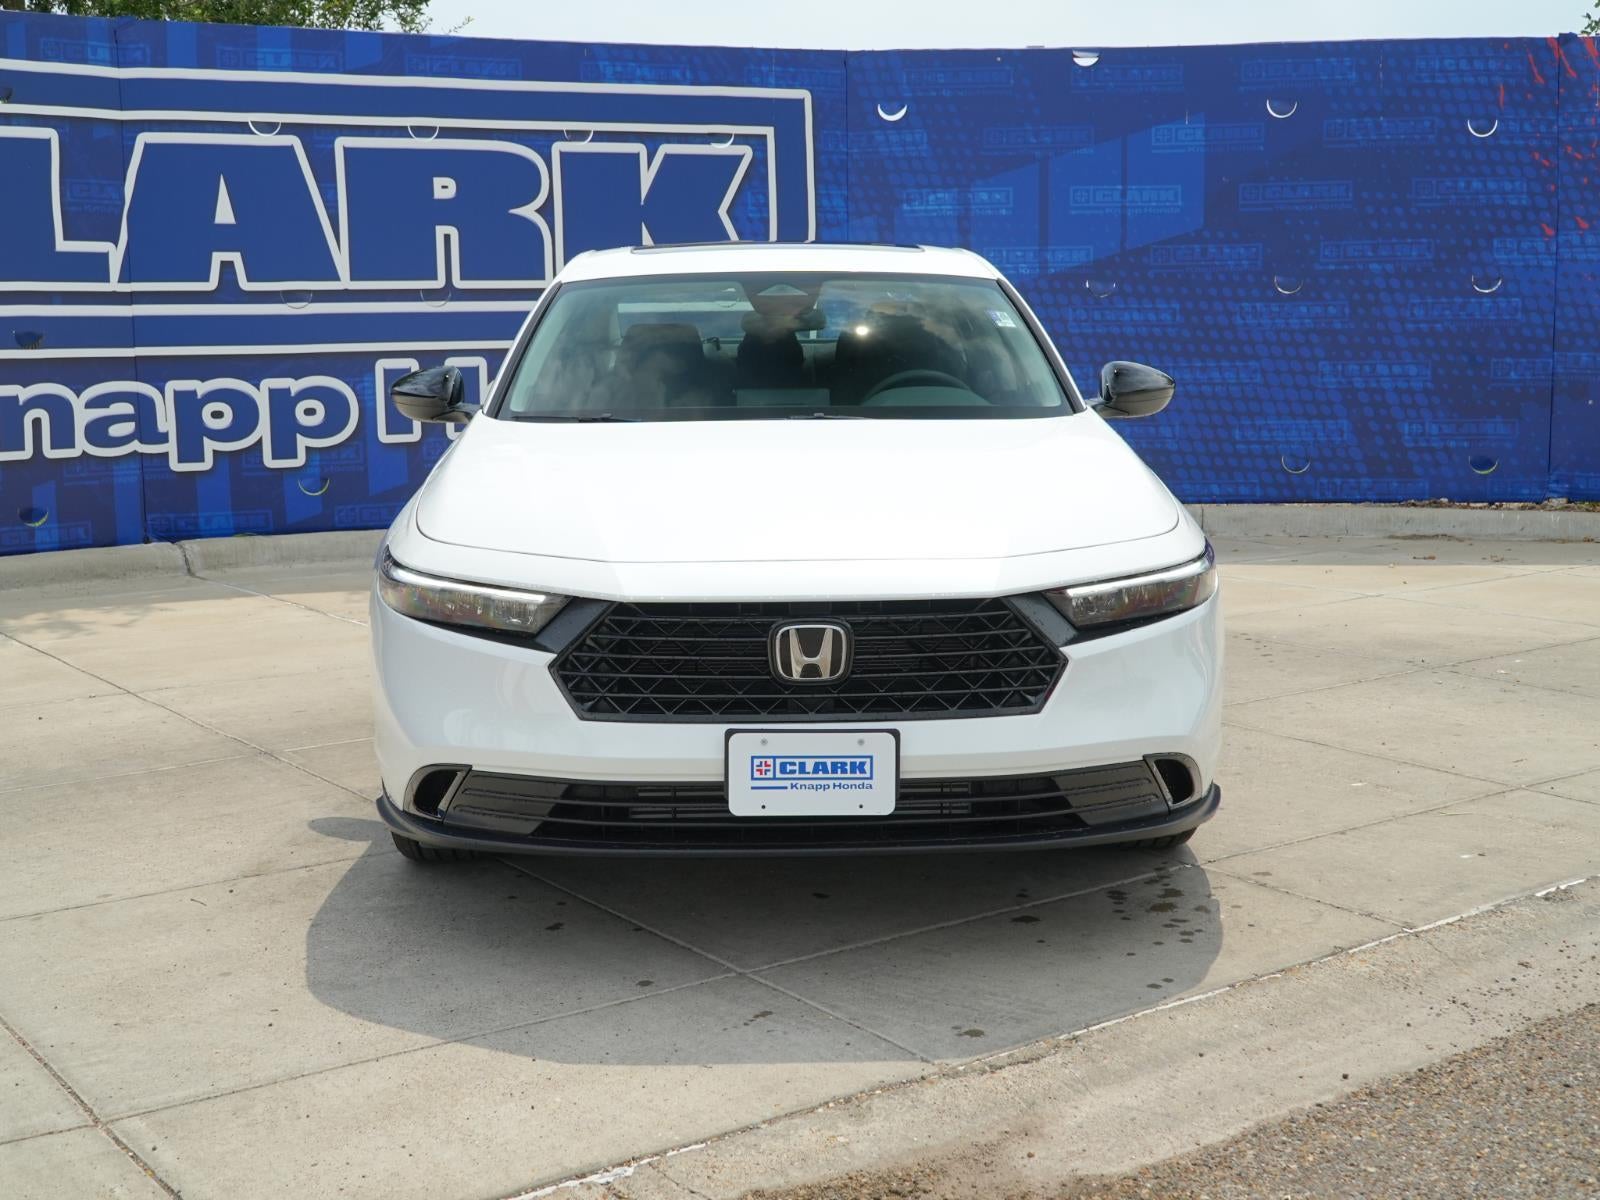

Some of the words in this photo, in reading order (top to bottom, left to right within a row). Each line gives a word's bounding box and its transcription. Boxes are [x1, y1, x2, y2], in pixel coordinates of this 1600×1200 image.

[779, 761, 867, 775] CLARK
[790, 782, 830, 791] Knapp
[832, 782, 873, 790] Honda
